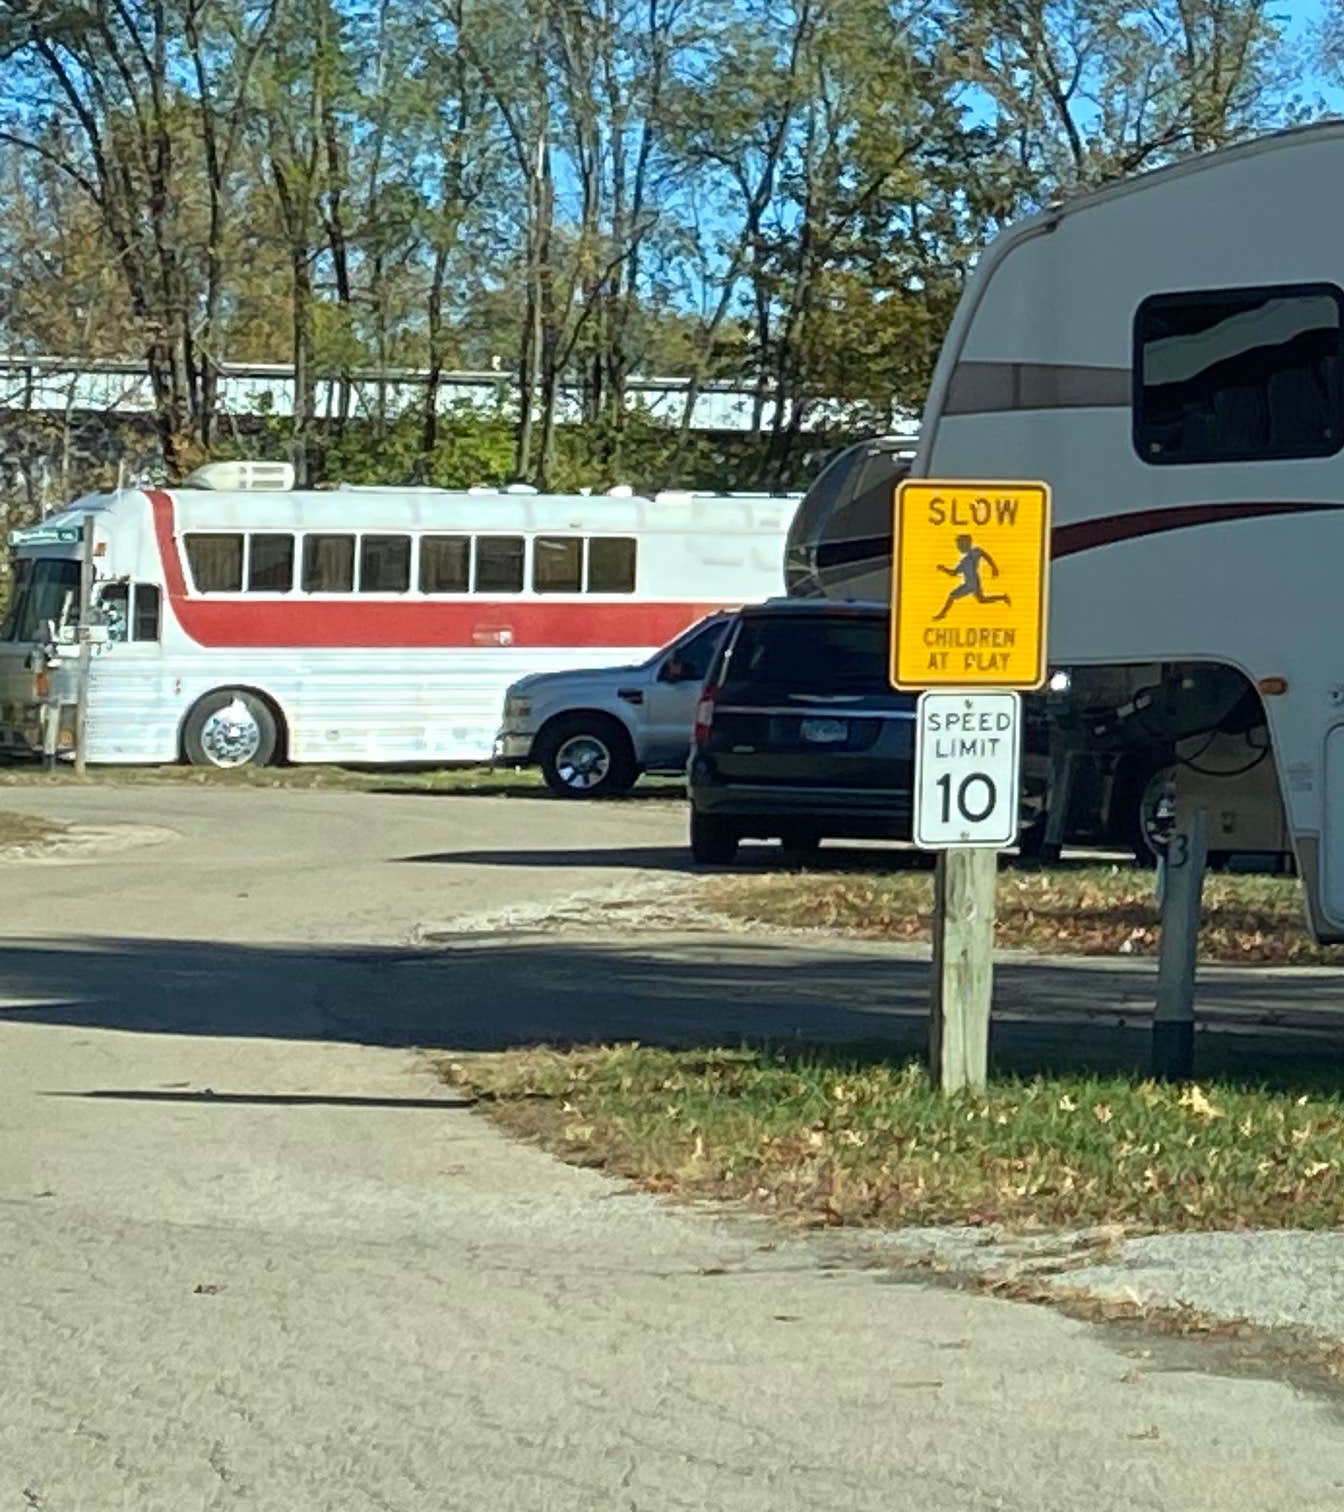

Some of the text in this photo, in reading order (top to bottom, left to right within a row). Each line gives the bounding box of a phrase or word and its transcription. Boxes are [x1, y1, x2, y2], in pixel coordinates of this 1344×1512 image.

[928, 497, 1019, 526] SLOW
[923, 627, 1017, 648] CHILDREN
[927, 651, 1011, 672] AT PLAY
[927, 712, 1011, 732] SPEED
[936, 738, 1000, 758] LIMIT
[936, 772, 997, 823] 10
